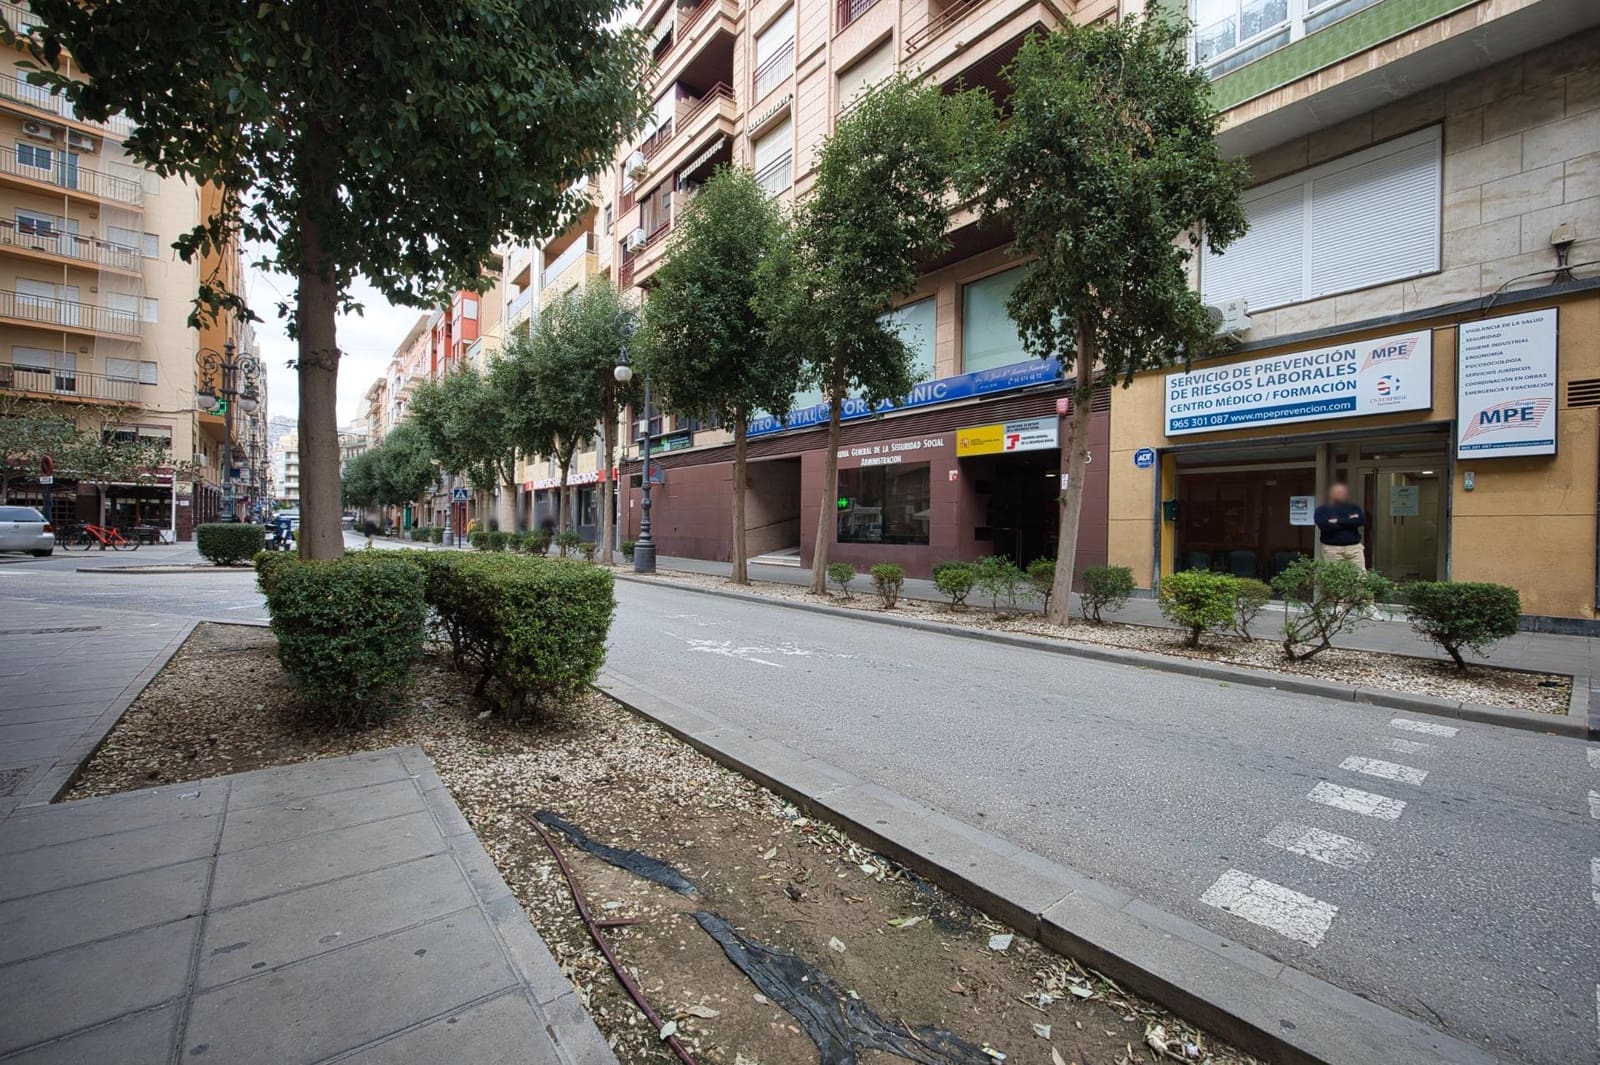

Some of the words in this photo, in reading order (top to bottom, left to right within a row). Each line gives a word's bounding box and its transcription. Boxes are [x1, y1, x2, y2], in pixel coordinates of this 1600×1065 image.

[1465, 324, 1501, 334] VIGILANCIA
[1521, 317, 1544, 325] SALUD
[1465, 333, 1502, 342] SEGURIDAD
[1465, 343, 1490, 352] HIGIENE
[1491, 338, 1528, 348] INDUSTRIAL
[1372, 344, 1408, 360] MPE
[1170, 370, 1229, 389] SERVICIO
[1232, 366, 1251, 379] DE
[1254, 348, 1356, 375] PREVENCIÓN
[1465, 369, 1496, 378] SERVICIOS
[1498, 365, 1532, 374] JURÍDICOS
[1170, 388, 1188, 401] DE
[1191, 377, 1253, 398] RIESGOS
[1257, 362, 1357, 388] LABORALES
[1465, 376, 1513, 387] COORDINACIÓN
[1465, 386, 1505, 396] EMERGENCIA
[1510, 381, 1554, 391] EVACUACIÓN
[845, 382, 948, 415] ORINIC
[1170, 399, 1213, 413] CENTRO
[1215, 391, 1263, 408] MÉDICO
[1272, 379, 1357, 399] FORMACIÓN
[1171, 419, 1189, 429] 965
[1191, 417, 1208, 427] 301
[1210, 414, 1228, 425] 087
[1230, 401, 1351, 422] www.mpeprevencion.com
[1479, 406, 1534, 425] MPE
[851, 447, 872, 457] GENERAL
[873, 446, 881, 454] DE
[882, 445, 889, 453] LA
[891, 441, 922, 452] SEGURIDAD
[923, 437, 944, 448] SOCIAL
